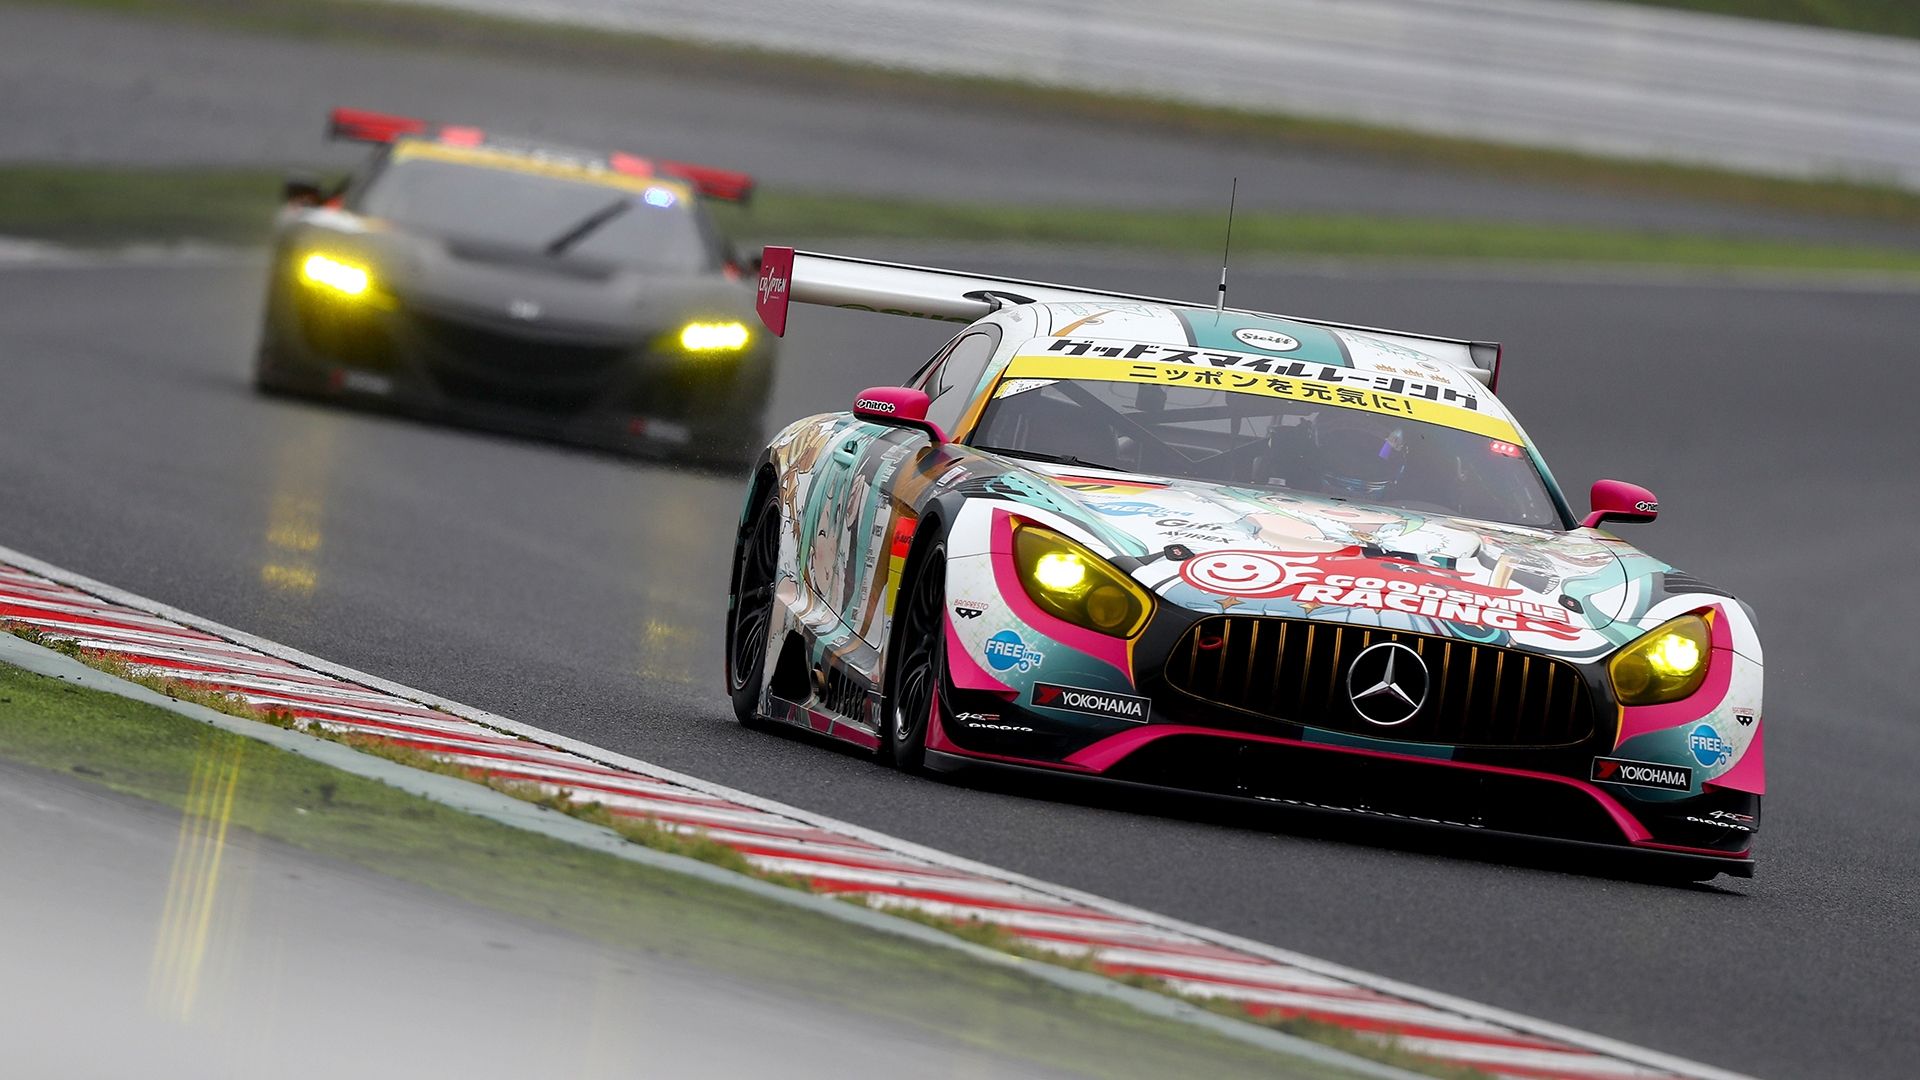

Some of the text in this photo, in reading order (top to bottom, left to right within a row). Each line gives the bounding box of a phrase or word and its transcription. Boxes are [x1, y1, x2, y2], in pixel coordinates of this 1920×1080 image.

[1241, 332, 1292, 345] Steiff
[1047, 339, 1478, 410] グッドスマイルレーシング
[1129, 365, 1413, 414] ニッポンを元気に!
[1155, 518, 1223, 531] Gift
[1157, 531, 1239, 544] AVIREX
[1297, 583, 1520, 630] RACING
[1323, 574, 1569, 623] GOODSMILE
[985, 639, 1042, 664] FREEing
[1062, 691, 1142, 717] YOKOHAMA
[1619, 765, 1687, 787] YOKOHAMA
